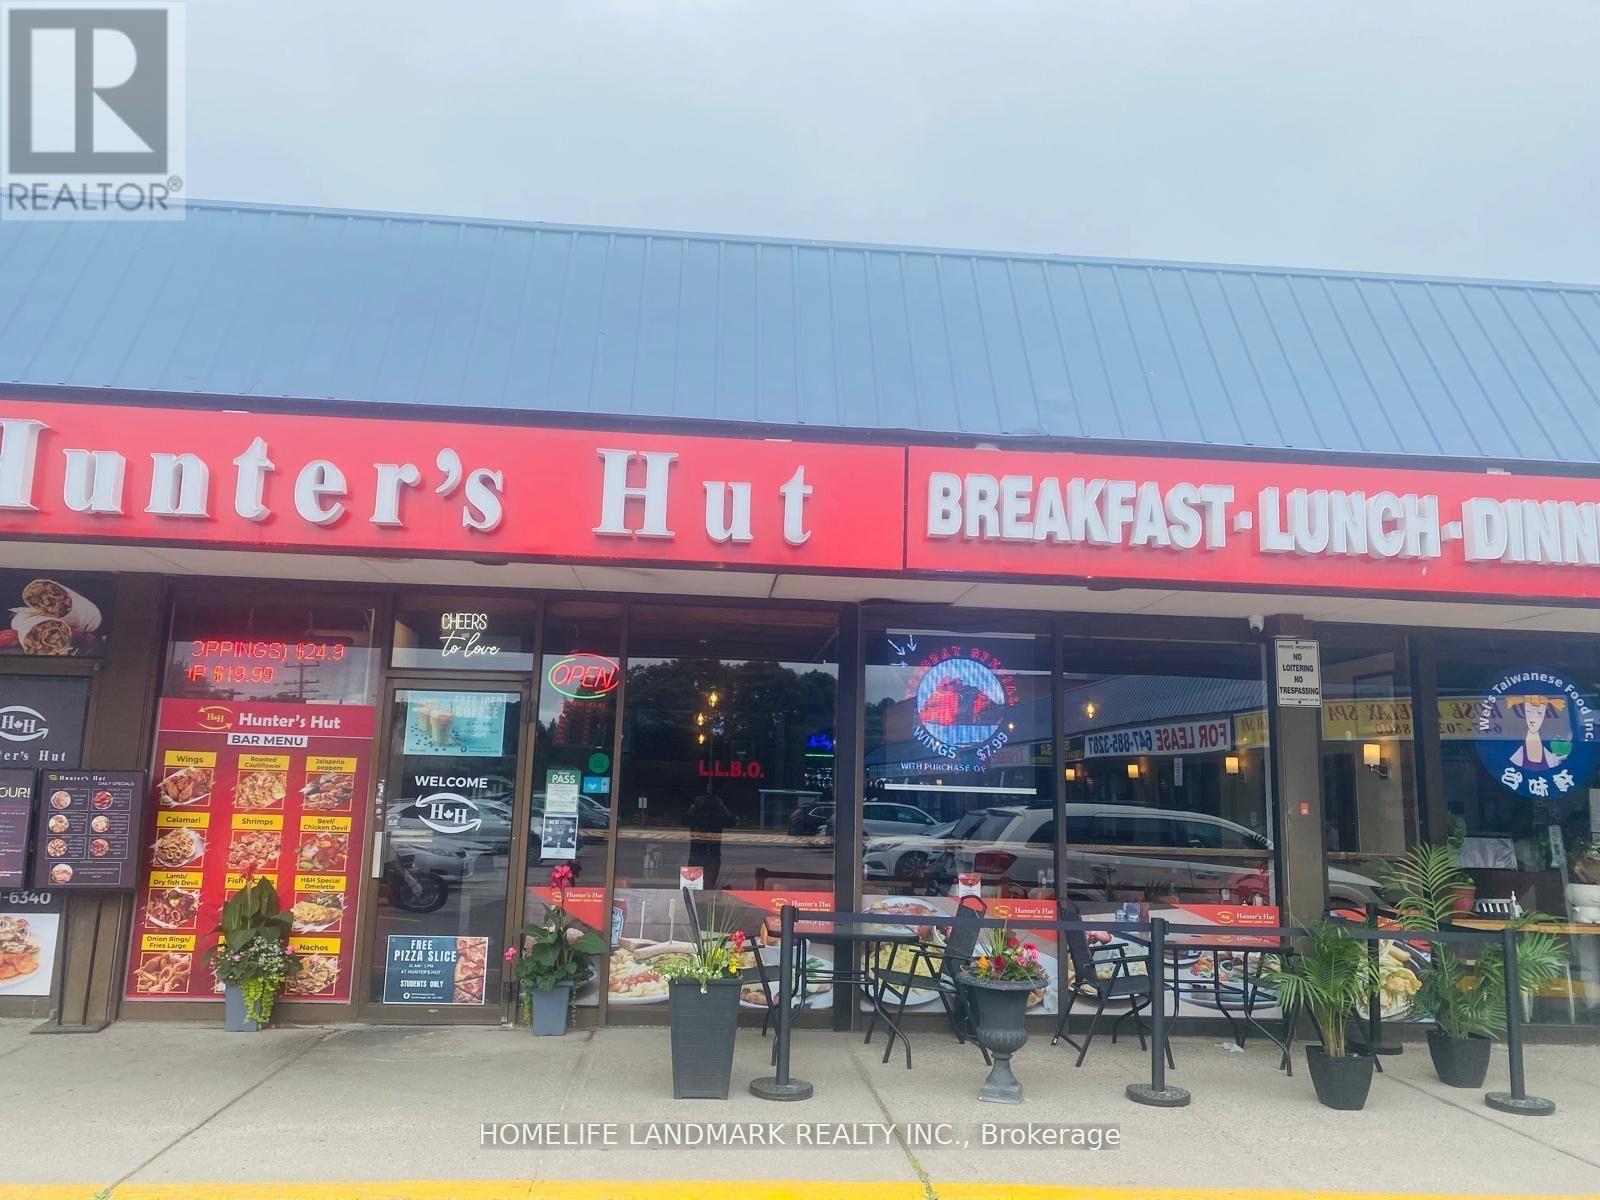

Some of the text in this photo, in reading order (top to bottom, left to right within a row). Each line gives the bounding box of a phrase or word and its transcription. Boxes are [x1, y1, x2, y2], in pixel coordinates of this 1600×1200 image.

[592, 448, 813, 545] Hut
[1462, 496, 1600, 567] DINN
[441, 612, 488, 631] CHEERS
[439, 631, 500, 657] to love
[1293, 653, 1302, 661] NO
[1283, 664, 1314, 673] LOITERING
[213, 665, 274, 684] $19.99
[552, 664, 615, 688] OPEN
[1294, 675, 1304, 683] NO
[1280, 686, 1319, 695] TRESPASSING
[1479, 671, 1595, 742] Wei's Taiwanese Food Inc.
[239, 712, 306, 728] Hunter's
[310, 715, 341, 729] Hut
[232, 734, 303, 746] BAR MENU
[912, 726, 957, 759] WINGS
[976, 732, 1008, 762] $7.99
[39, 749, 66, 762] Hut
[176, 755, 203, 764] Wings
[698, 760, 765, 778] L.L.B.O.
[901, 762, 923, 771] WITH
[924, 763, 970, 773] PURCHASE
[415, 775, 488, 789] WELCOME
[552, 774, 576, 784] PASS
[166, 816, 201, 824] Calamari
[241, 817, 274, 826] Shrimps
[166, 879, 180, 887] fish
[319, 877, 341, 886] Special
[791, 899, 817, 907] Hunter's
[1042, 907, 1054, 915] Hut
[147, 935, 191, 944] Onion Rings/
[410, 939, 433, 950] FREE
[299, 943, 329, 951] Nachos
[394, 950, 457, 963] PIZZA SLICE
[400, 979, 444, 988] STUDENTS ONLY
